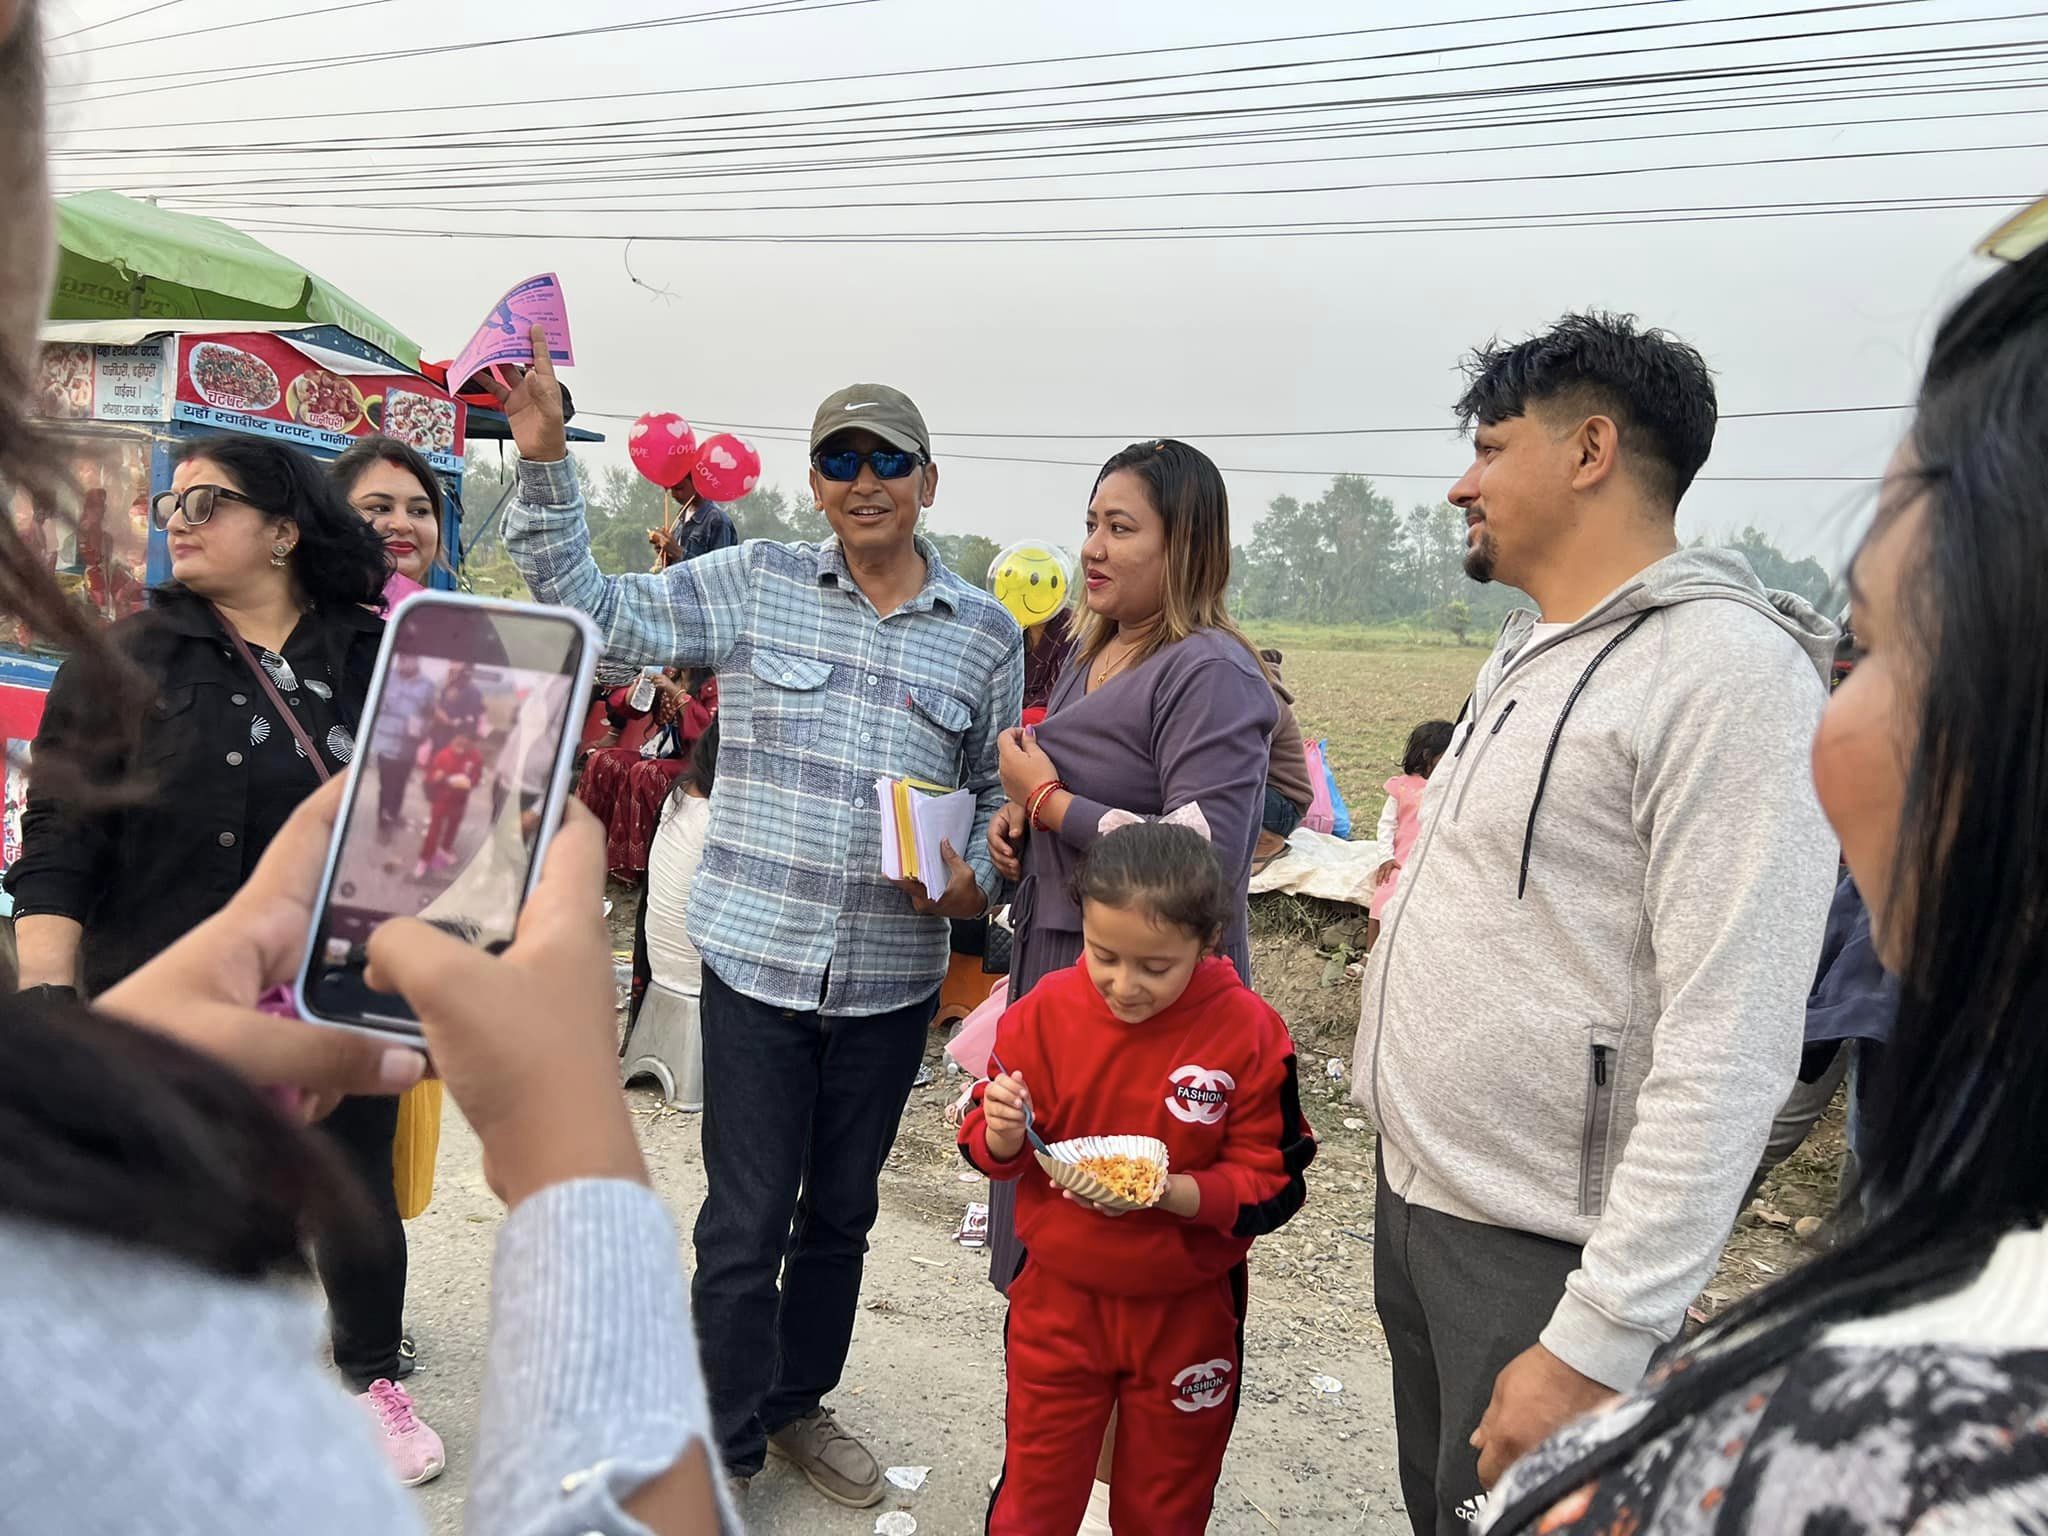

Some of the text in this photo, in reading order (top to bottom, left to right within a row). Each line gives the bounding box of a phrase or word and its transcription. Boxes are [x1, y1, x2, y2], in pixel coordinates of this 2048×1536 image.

[206, 390, 246, 409] चटपट
[183, 405, 211, 420] यहाँ
[630, 446, 649, 458] OVE
[1177, 1086, 1223, 1102] FASHION
[1182, 1376, 1223, 1395] FASHION
